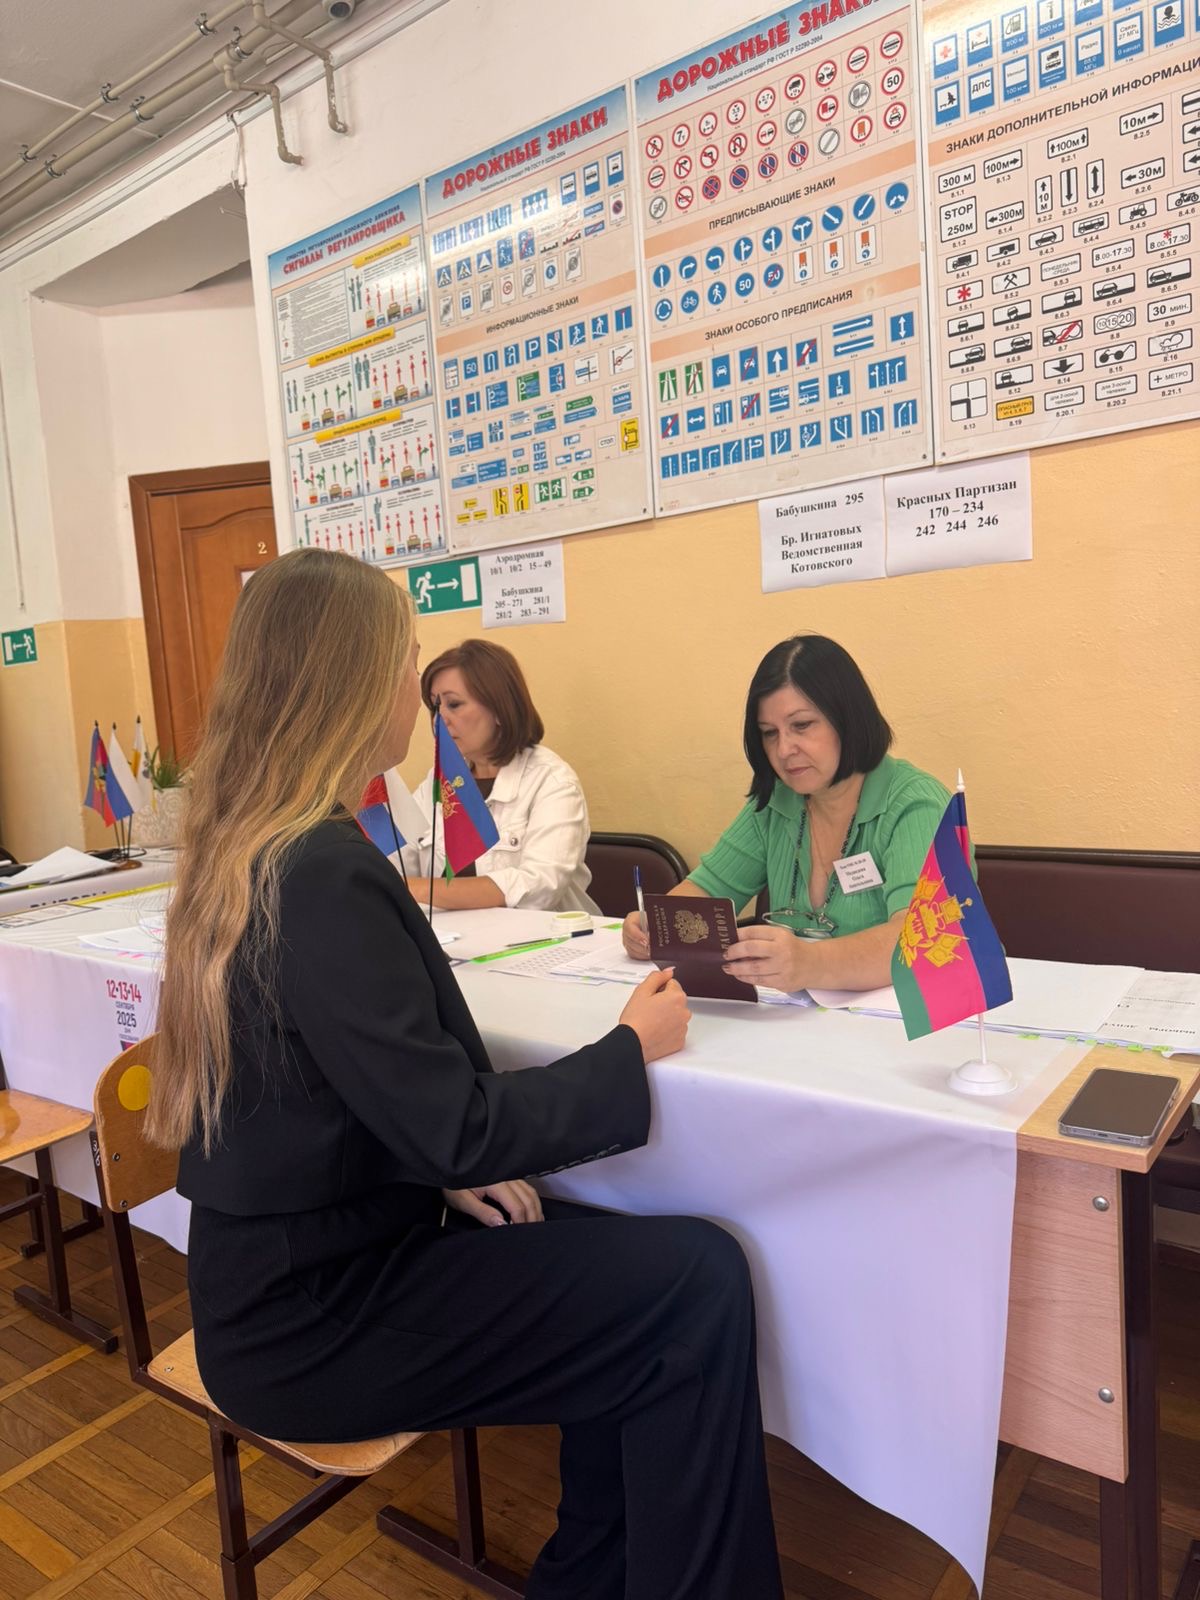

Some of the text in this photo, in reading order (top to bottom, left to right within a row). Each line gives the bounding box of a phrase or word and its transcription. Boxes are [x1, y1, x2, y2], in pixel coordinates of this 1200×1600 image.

[657, 0, 879, 102] ДОРОЖНЫЕ ЗНАК
[775, 49, 790, 61] ГОСТ
[887, 74, 900, 88] 50
[972, 79, 991, 93] ДПС
[946, 132, 984, 153] ЗНАКИ
[987, 88, 1108, 141] ДОПОЛНИТЕЛЬНОЙ
[1123, 115, 1146, 130] 10м
[442, 106, 608, 199] ДОРОЖНЫЕ ЗНАКИ
[1056, 138, 1080, 152] 100м
[986, 160, 1010, 174] 100м
[1138, 166, 1162, 180] 30м
[943, 175, 961, 188] 300
[708, 176, 836, 230] ПРЕДПИСЫВАЮЩИЕ ЗНАКИ
[1039, 193, 1049, 203] 10
[944, 203, 973, 220] STOP
[998, 208, 1023, 222] 300м
[947, 222, 973, 237] 250м
[283, 248, 324, 275] СИГНАЛЫ
[327, 210, 406, 256] РЕГУЛИРОВЩИКА
[739, 279, 751, 291] 50
[463, 297, 471, 309] P
[486, 296, 579, 334] ИНФОРМАЦИОННЫЕ ЗНАКИ
[705, 289, 853, 341] ЗНАКИ ОСОБОГО ПРЕДПИСАНИЯ
[1152, 305, 1167, 317] 30
[528, 340, 539, 358] P
[1165, 370, 1188, 381] МЕТРО
[896, 479, 1017, 511] Красных Партизан
[775, 492, 864, 519] Бабушкина 295
[929, 506, 949, 520] 170
[963, 501, 985, 515] 234
[915, 514, 999, 538] 242 244 246
[780, 524, 862, 549] Бр. Игнатовых
[257, 541, 268, 554] 2
[781, 539, 863, 561] Ведомственная
[496, 551, 544, 563] Аэродромная
[509, 564, 522, 573] 10/2
[529, 562, 537, 570] 15
[544, 560, 552, 568] 49
[790, 557, 853, 575] Котовского
[502, 586, 542, 597] Бабушкина
[495, 596, 550, 609] 205 271 281/1
[496, 607, 550, 620] 281/2 283 291
[713, 906, 731, 950] ПАСПОРТ
[116, 1010, 137, 1028] 2025
